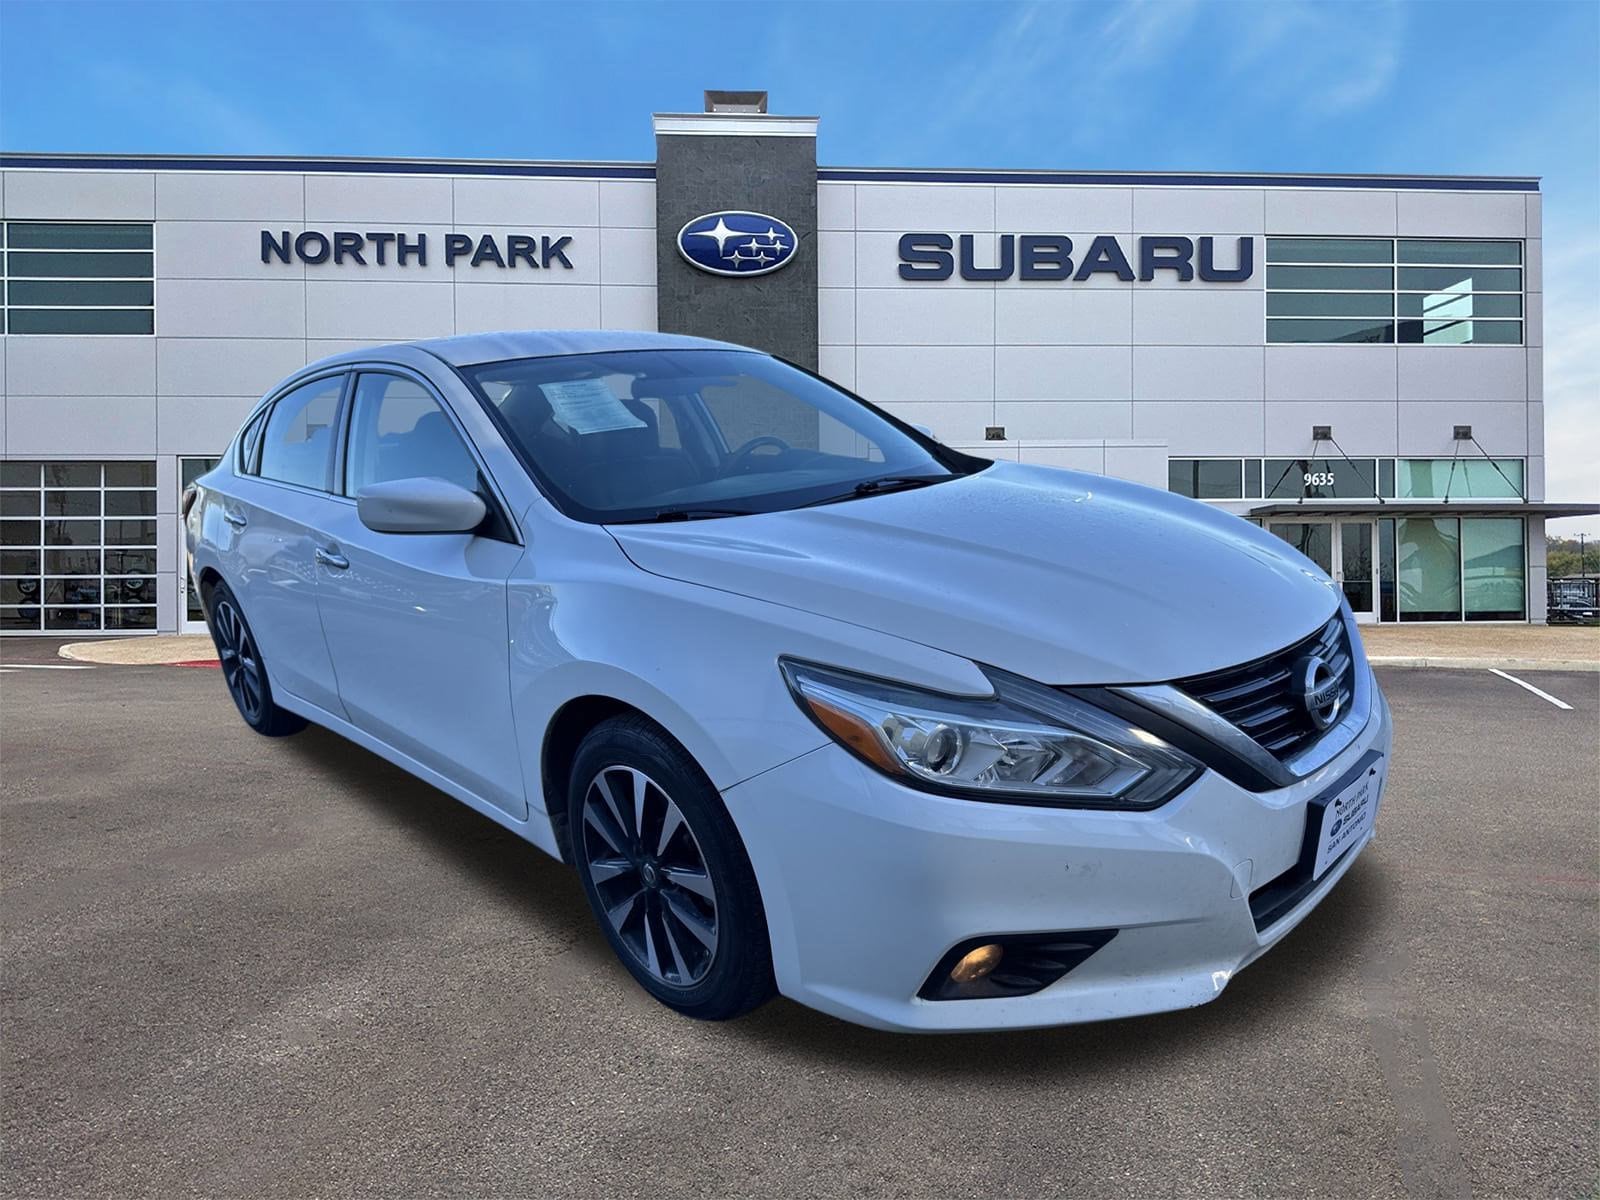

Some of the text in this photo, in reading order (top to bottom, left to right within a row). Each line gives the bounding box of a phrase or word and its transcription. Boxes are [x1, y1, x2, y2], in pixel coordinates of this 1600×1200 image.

[261, 231, 573, 269] NORTH PARK
[897, 232, 1254, 283] SUBARU
[1303, 473, 1335, 487] 9635
